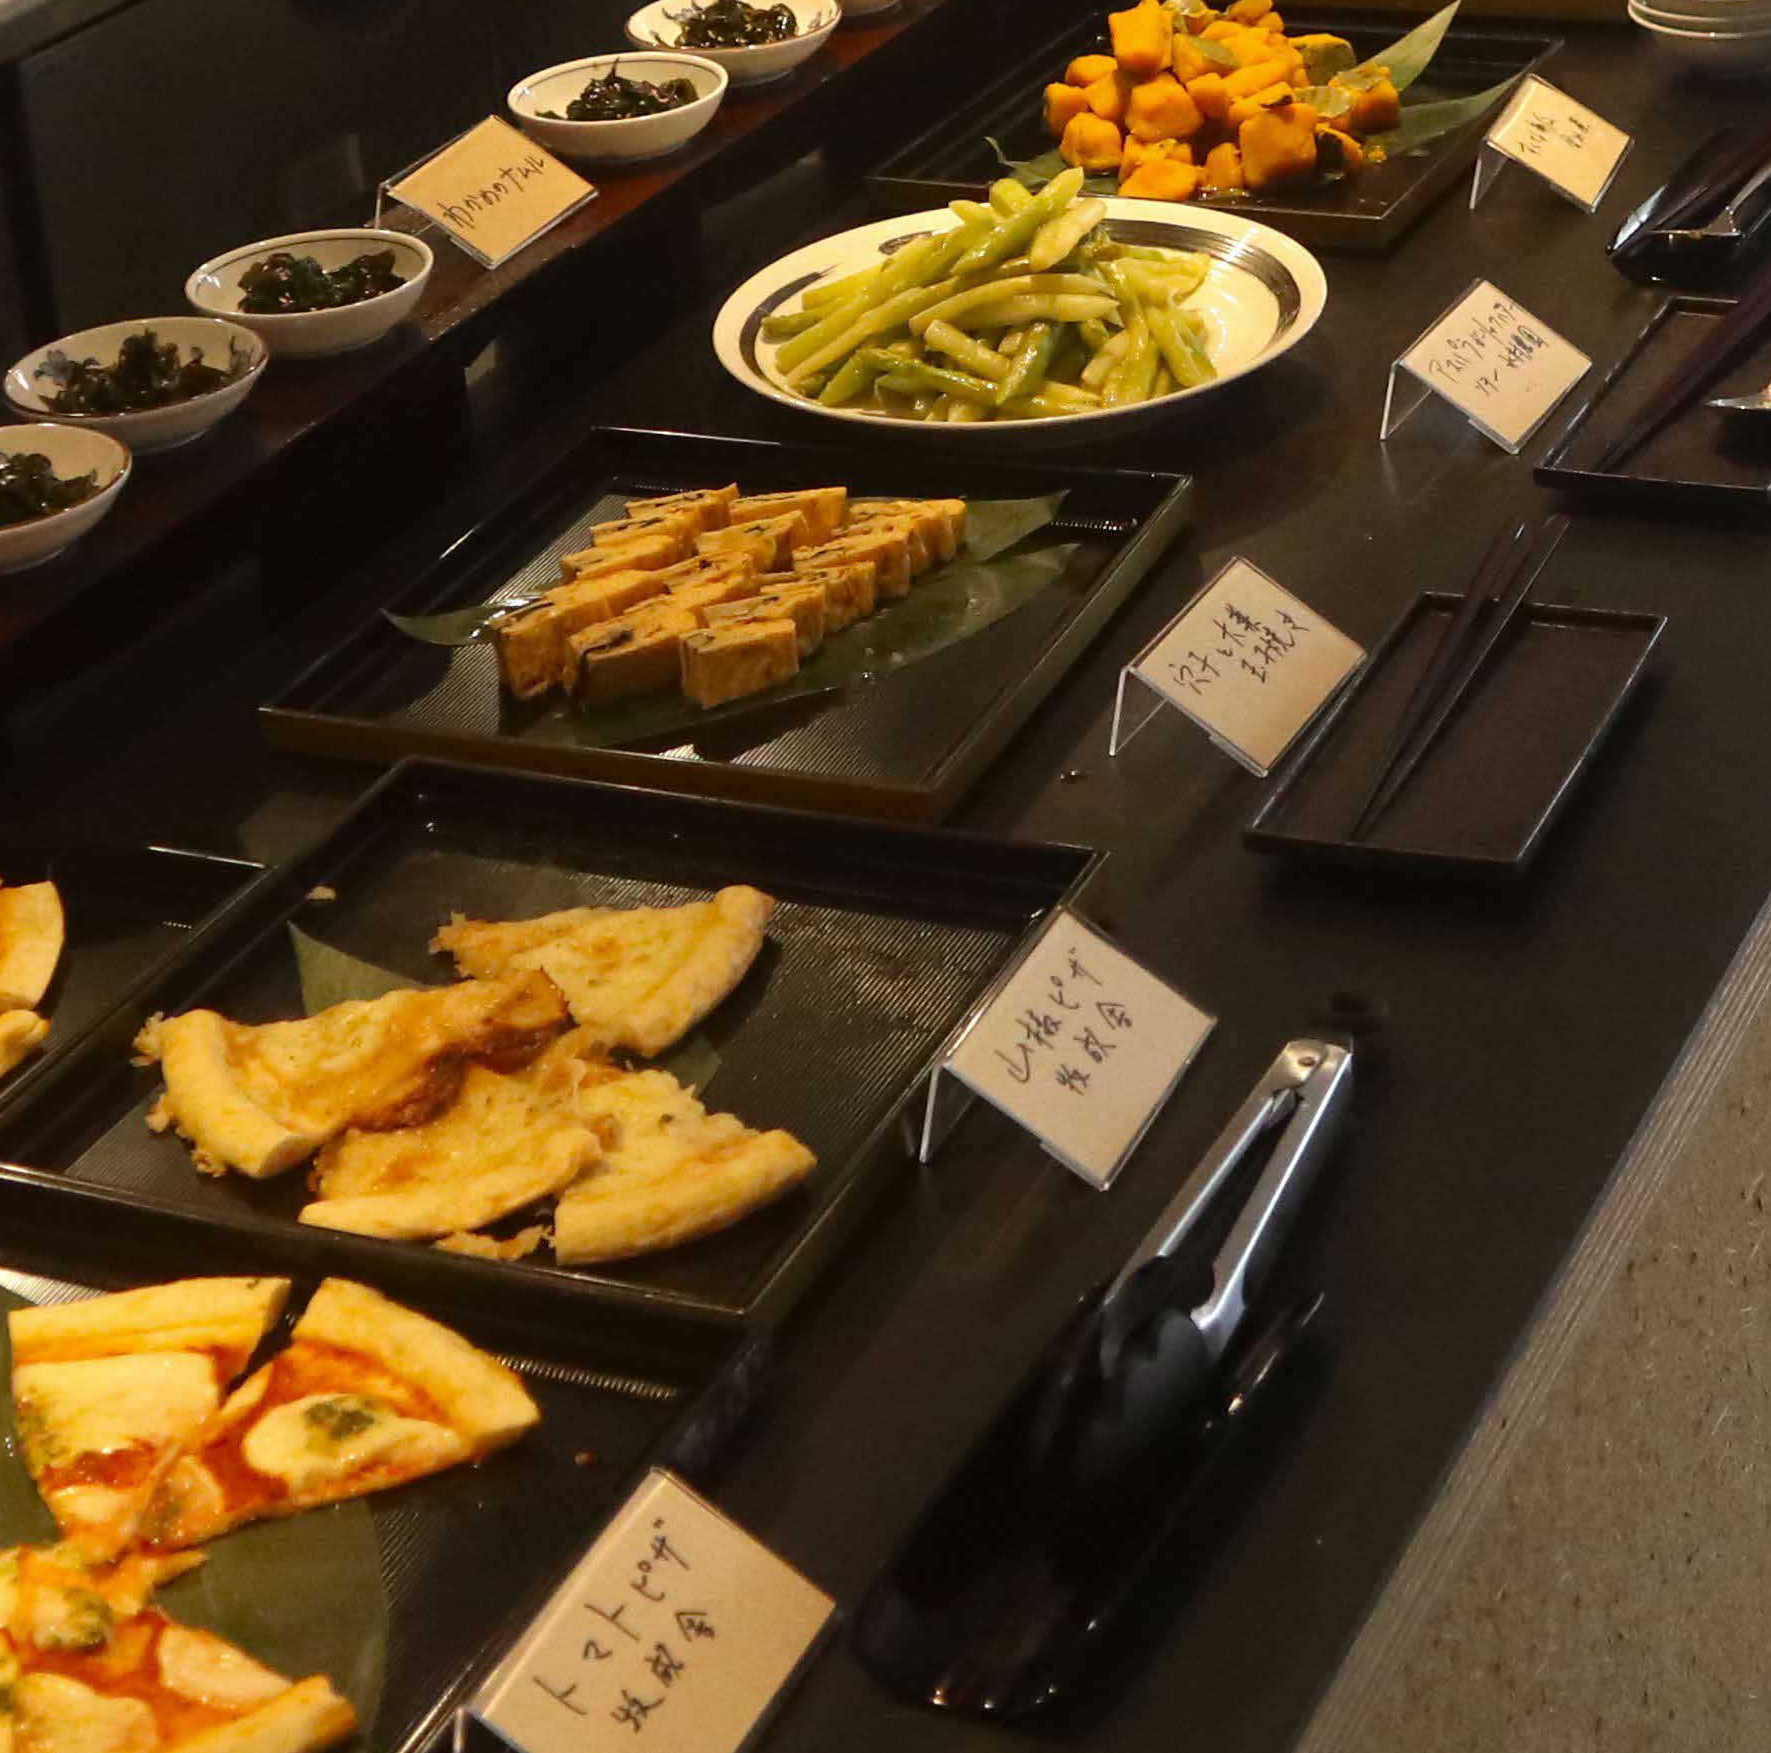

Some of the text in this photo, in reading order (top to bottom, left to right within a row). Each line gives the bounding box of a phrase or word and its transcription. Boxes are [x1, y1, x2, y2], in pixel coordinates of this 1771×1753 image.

[436, 154, 545, 230] わかめのナムル
[532, 1516, 691, 1716] トマトピザ
